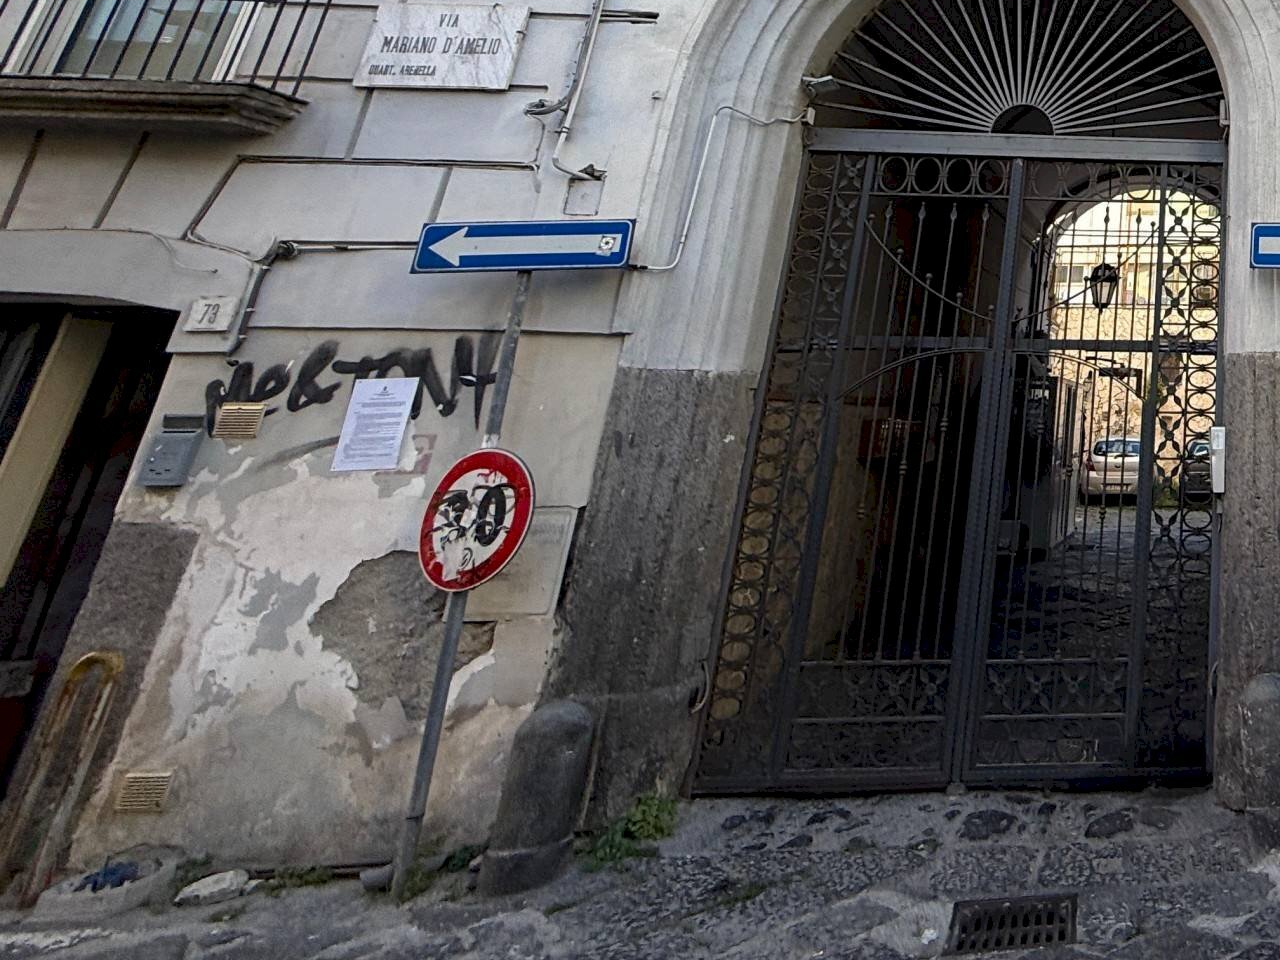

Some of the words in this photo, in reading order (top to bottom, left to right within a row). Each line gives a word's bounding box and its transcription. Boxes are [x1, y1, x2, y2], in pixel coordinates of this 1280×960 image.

[438, 13, 460, 29] VIA
[380, 36, 437, 54] MARIANO
[441, 36, 502, 56] D'AMELIO
[197, 303, 221, 325] 73
